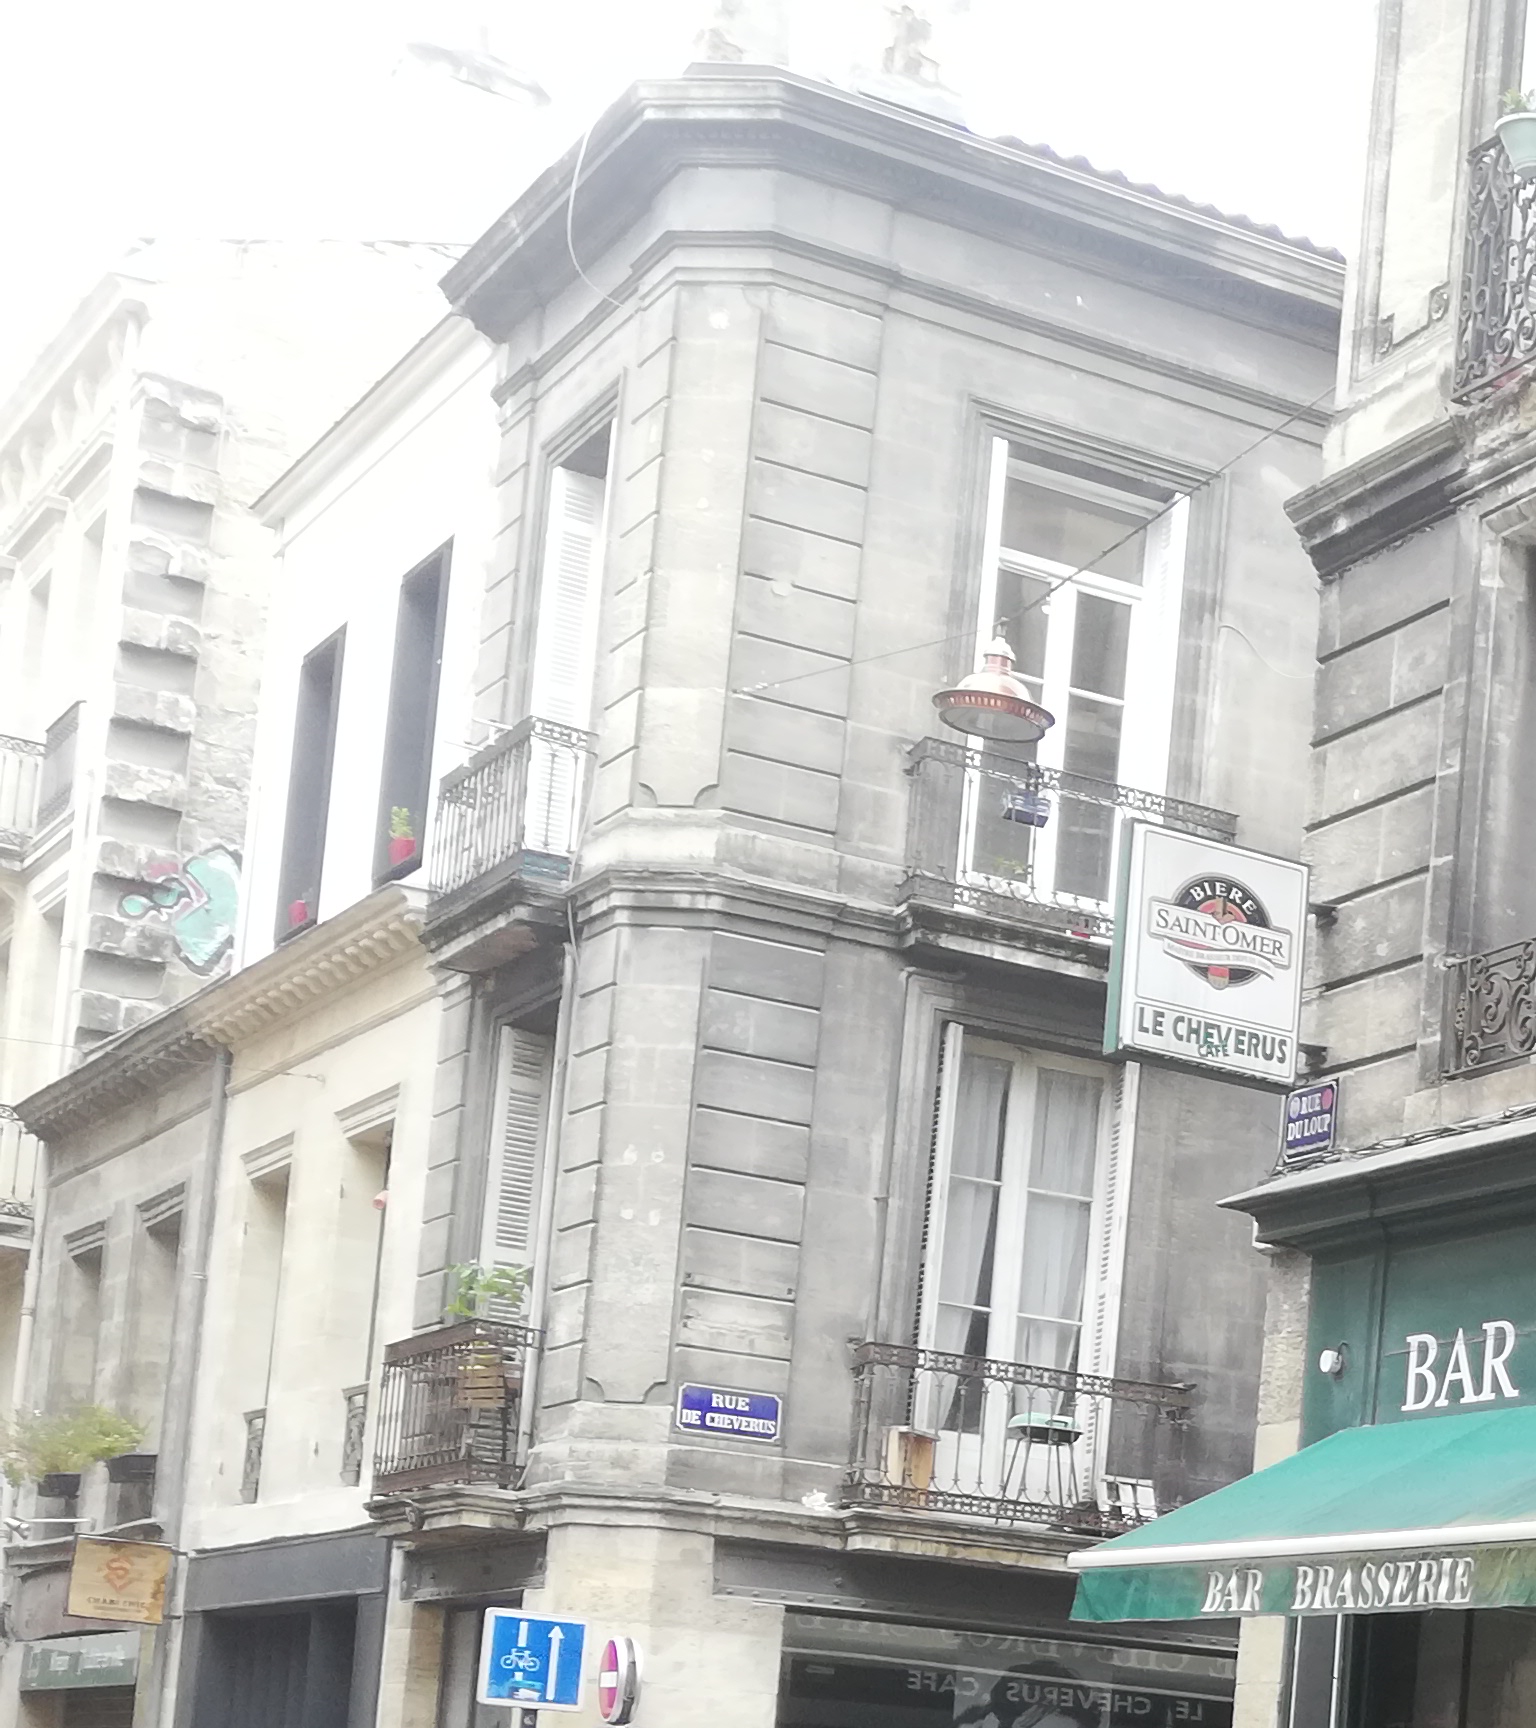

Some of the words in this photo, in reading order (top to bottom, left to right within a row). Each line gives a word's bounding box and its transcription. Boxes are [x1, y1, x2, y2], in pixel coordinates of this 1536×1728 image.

[1137, 1006, 1164, 1037] LE
[1172, 1014, 1287, 1064] CHEVERUS
[1300, 1091, 1321, 1115] RUE
[1287, 1119, 1302, 1141] DU
[1303, 1113, 1331, 1137] LOUP
[1401, 1319, 1519, 1411] BAR
[712, 1393, 750, 1411] RUE
[681, 1409, 701, 1425] DE
[705, 1412, 776, 1434] CHEVERUS
[1201, 1567, 1263, 1613] BAR
[1290, 1557, 1475, 1611] BRASSERIE
